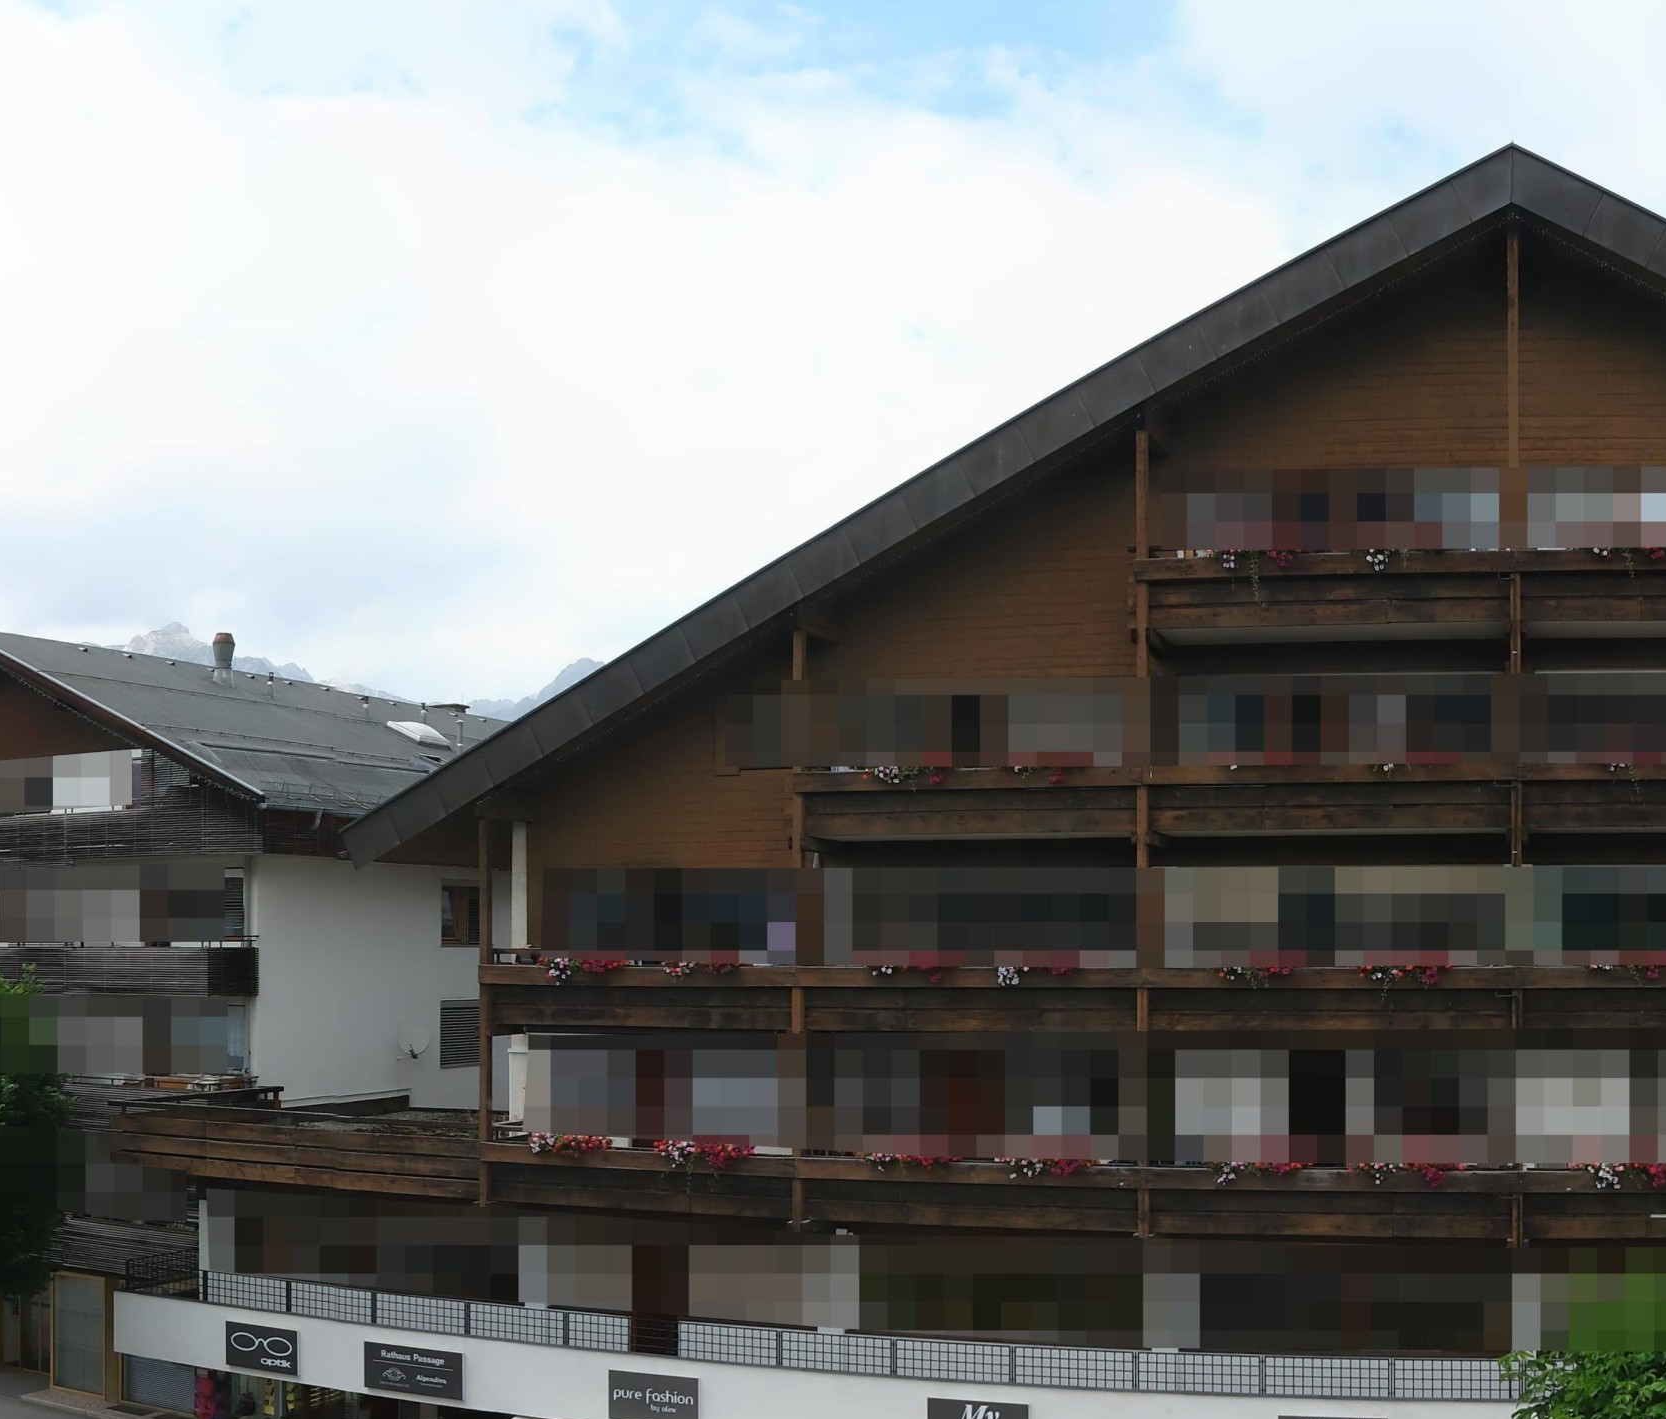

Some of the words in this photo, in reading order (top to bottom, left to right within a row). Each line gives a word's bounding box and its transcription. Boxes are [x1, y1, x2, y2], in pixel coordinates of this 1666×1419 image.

[260, 1357, 292, 1369] optik
[380, 1349, 411, 1362] Rathaus
[412, 1352, 445, 1366] Passage
[613, 1388, 642, 1401] pure
[645, 1388, 694, 1406] fashion
[650, 1404, 660, 1414] by
[661, 1404, 677, 1413] alex
